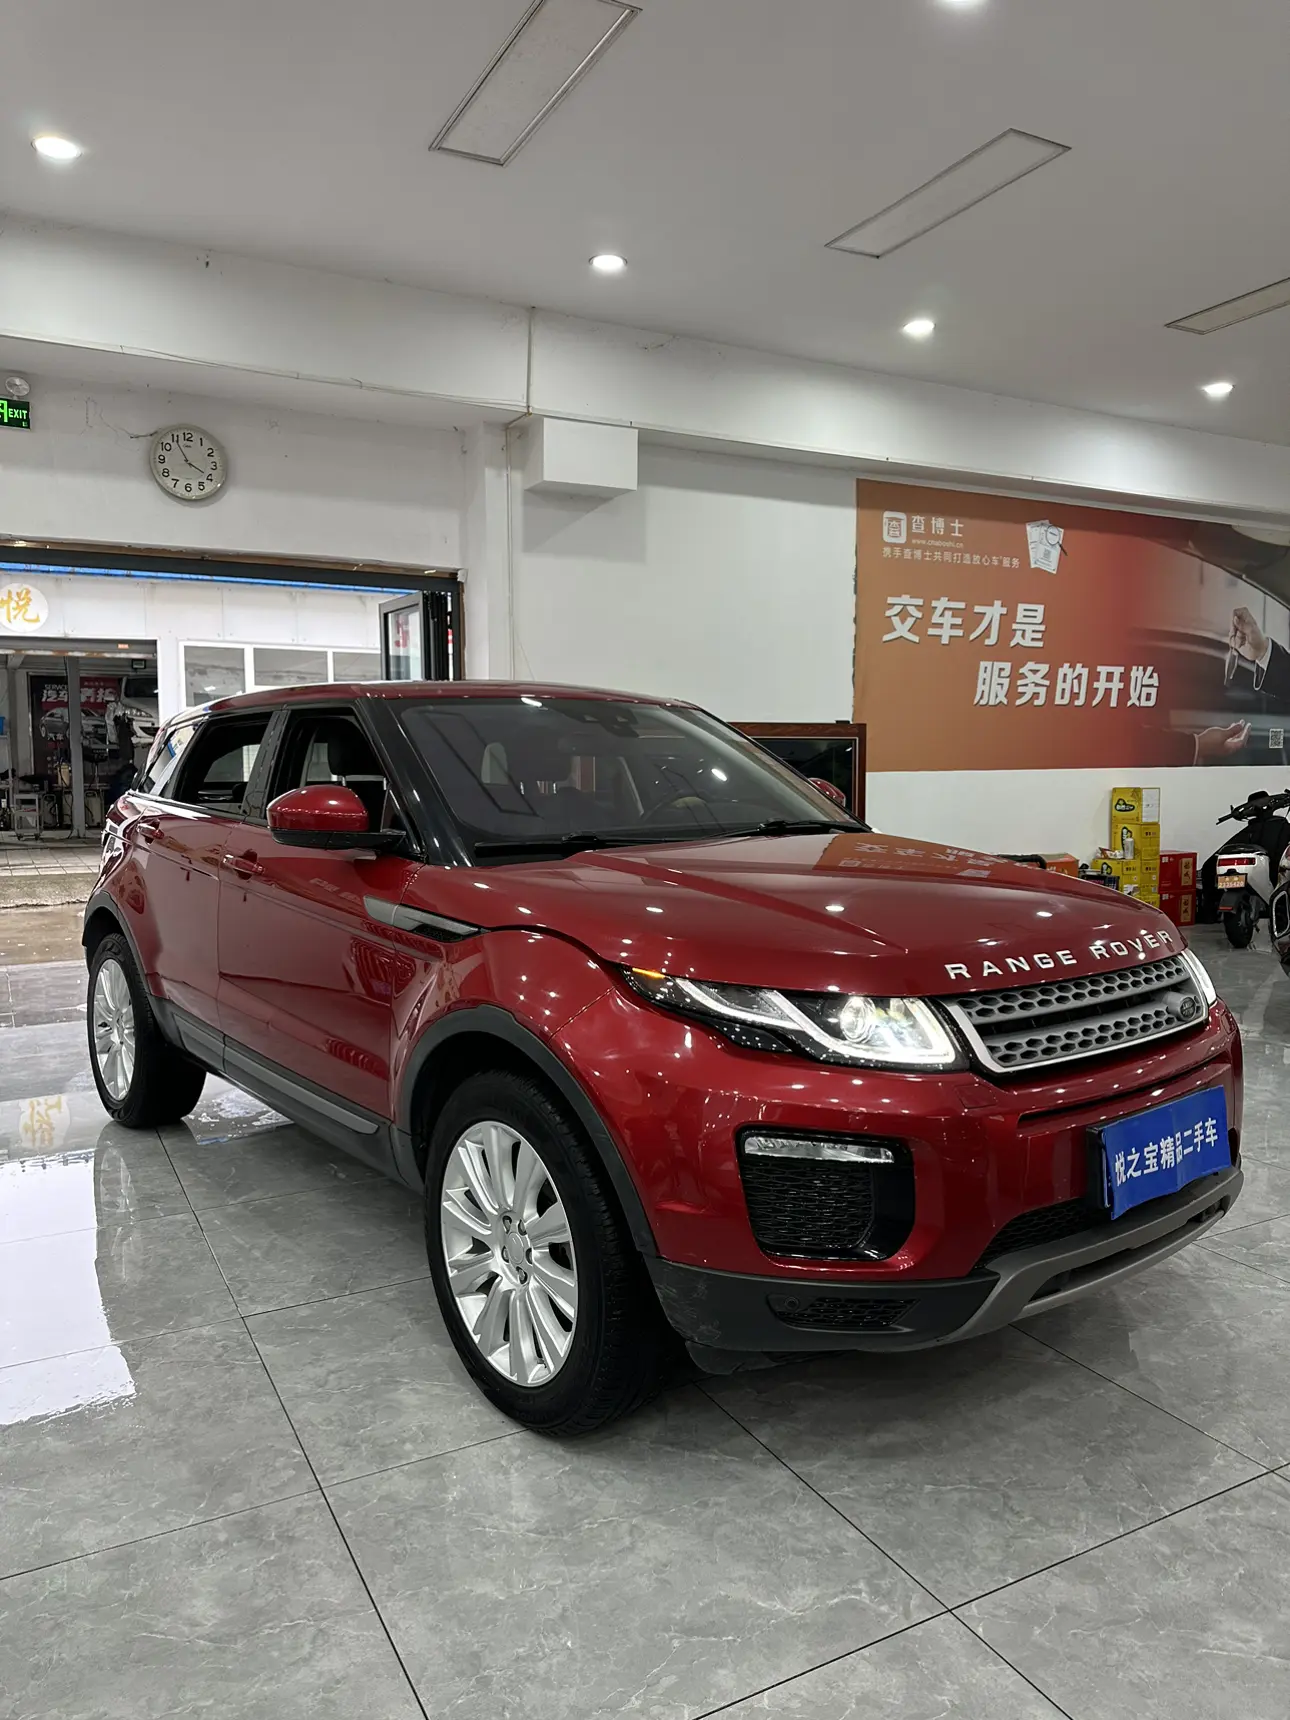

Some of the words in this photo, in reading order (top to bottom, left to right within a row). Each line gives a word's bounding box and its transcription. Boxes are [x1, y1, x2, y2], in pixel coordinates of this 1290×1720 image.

[8, 408, 28, 420] EXIT
[171, 433, 180, 443] 11
[183, 432, 194, 442] 12
[199, 437, 204, 447] 1
[161, 441, 172, 452] 10
[207, 447, 215, 457] 2
[158, 454, 166, 464] 9
[210, 461, 218, 471] 3
[161, 468, 170, 478] 8
[206, 473, 214, 482] 4
[171, 478, 180, 488] 7
[184, 483, 192, 493] 6
[198, 481, 206, 491] 5
[911, 514, 965, 537] 查博士
[882, 594, 1046, 648] 交车才是
[973, 660, 1160, 708] 服务的开始
[944, 949, 1078, 980] RANGE
[1088, 929, 1174, 960] ROVER
[1115, 1117, 1218, 1187] 悦之宝精品二手车
